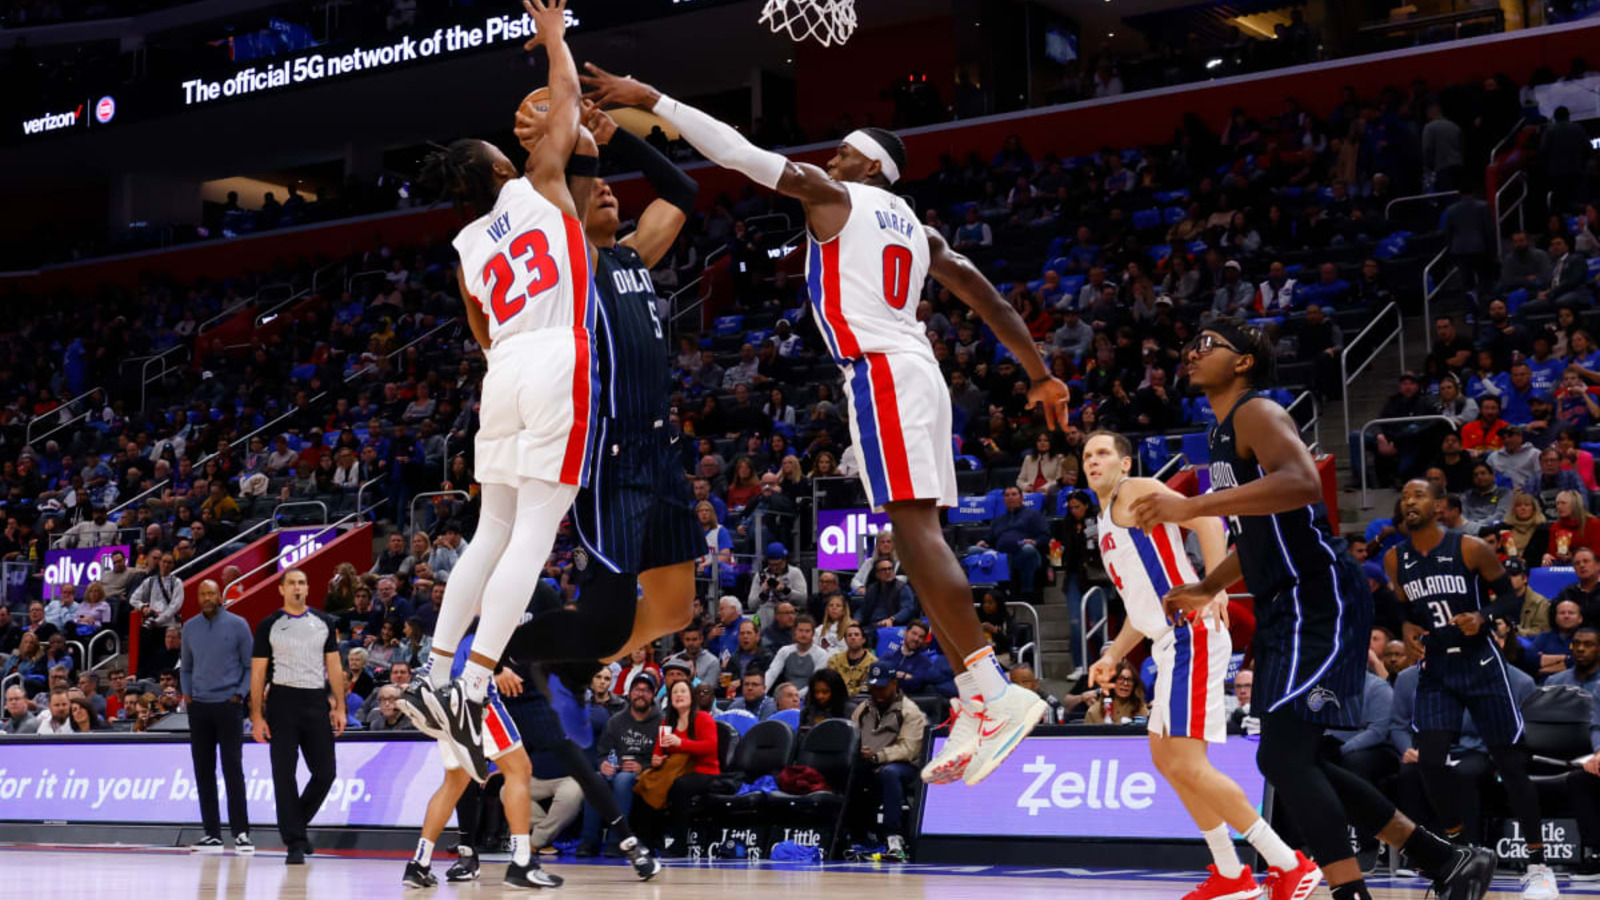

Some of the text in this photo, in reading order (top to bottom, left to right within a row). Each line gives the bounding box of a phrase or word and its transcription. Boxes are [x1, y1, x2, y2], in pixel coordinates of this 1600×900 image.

[182, 9, 580, 105] The official 5G network of the Pists.
[23, 111, 76, 135] verizon
[486, 211, 512, 243] IVEY
[482, 228, 560, 326] 23
[882, 243, 913, 310] 0
[279, 534, 323, 569] all
[44, 556, 85, 586] ally
[1403, 574, 1467, 602] ORLANDO
[1427, 600, 1453, 628] 31
[35, 768, 58, 799] it
[62, 768, 89, 799] in
[91, 777, 165, 809] your
[1016, 756, 1156, 815] Zelle
[784, 828, 821, 846] Little
[1511, 821, 1566, 842] Ltle
[1496, 837, 1574, 860] Caears
